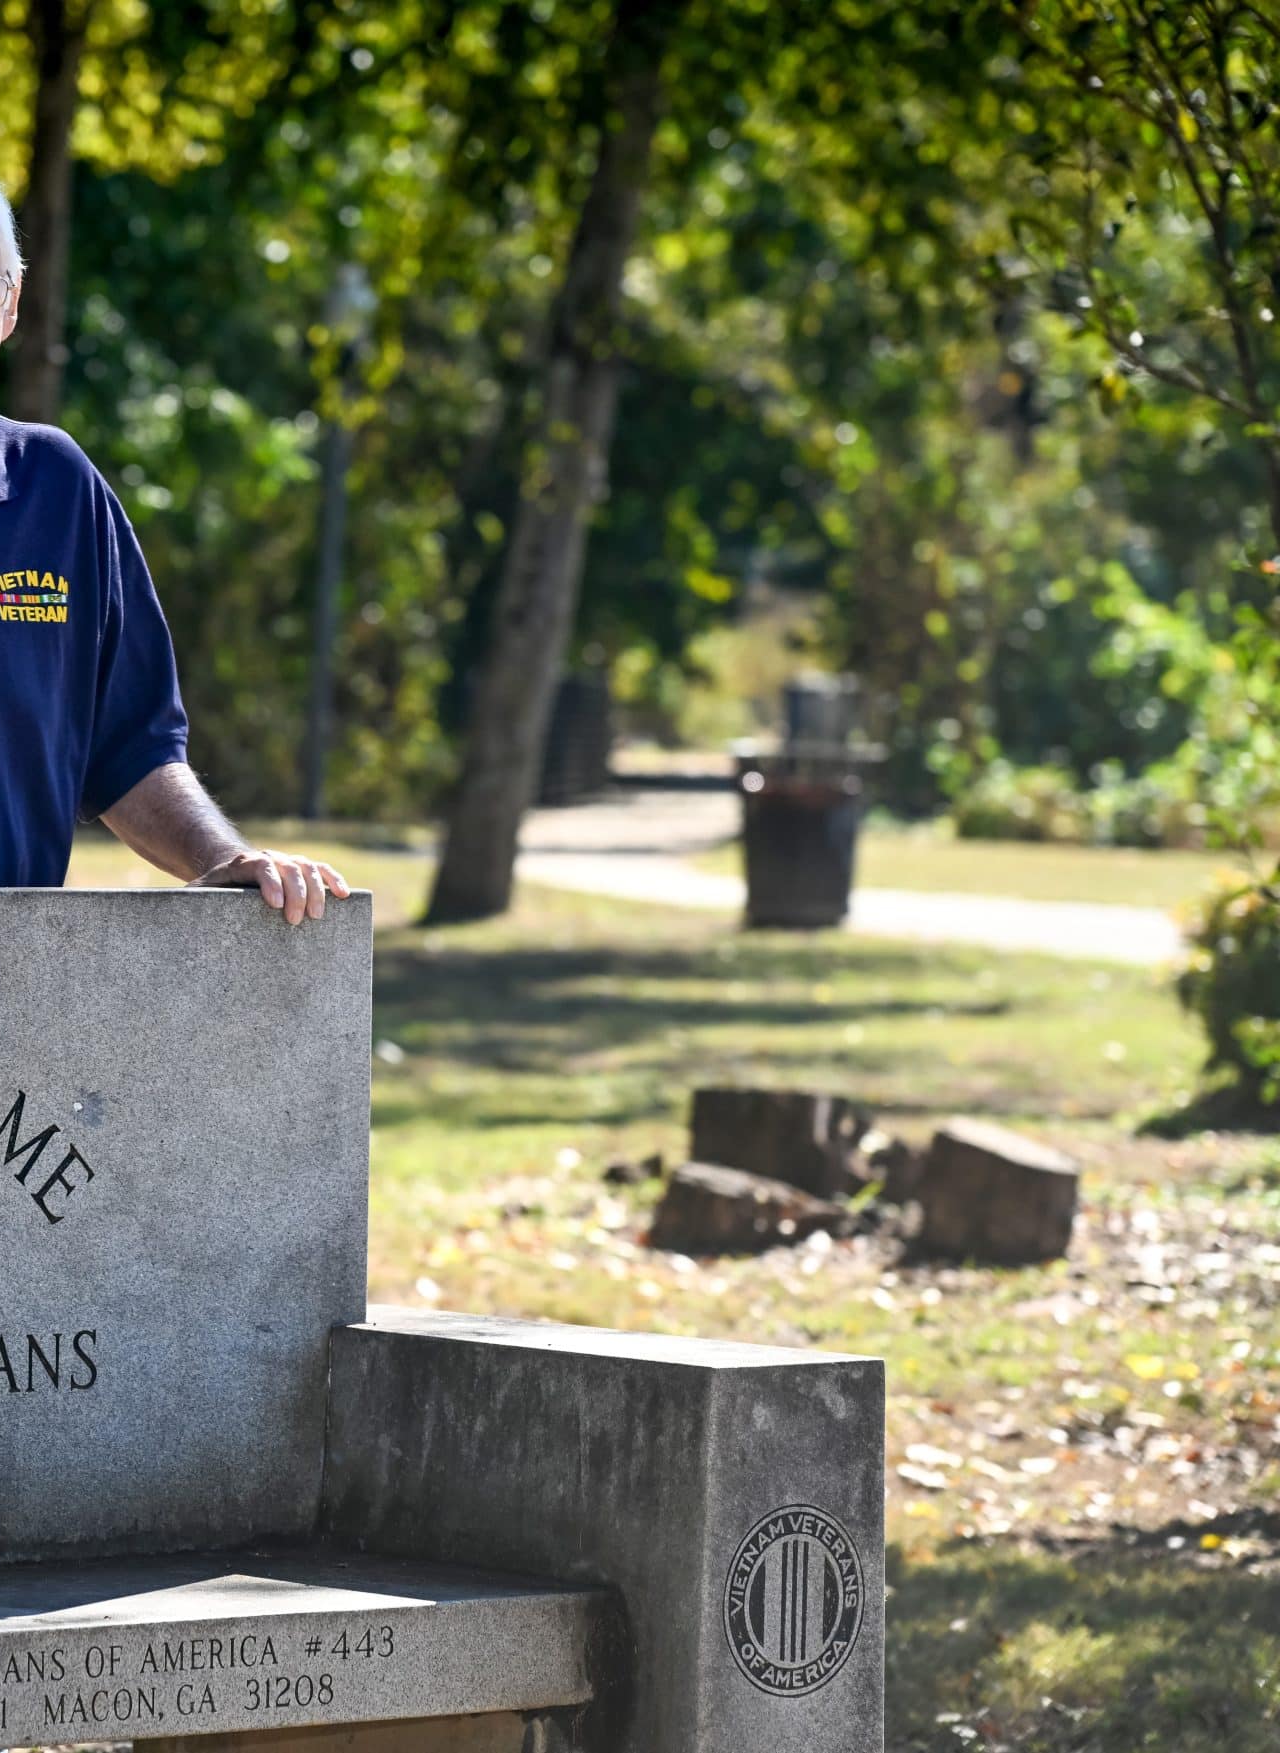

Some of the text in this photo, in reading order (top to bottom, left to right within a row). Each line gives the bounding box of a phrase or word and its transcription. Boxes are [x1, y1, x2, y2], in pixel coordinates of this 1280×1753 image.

[730, 1514, 858, 1617] VIETNAM VETERANS
[85, 1645, 123, 1679] OF
[140, 1635, 278, 1674] AMERICA
[305, 1626, 394, 1660] #443
[741, 1640, 848, 1688] OF AMERICA
[43, 1687, 164, 1727] MACON,
[176, 1684, 217, 1715] GA
[244, 1673, 334, 1711] 31208
